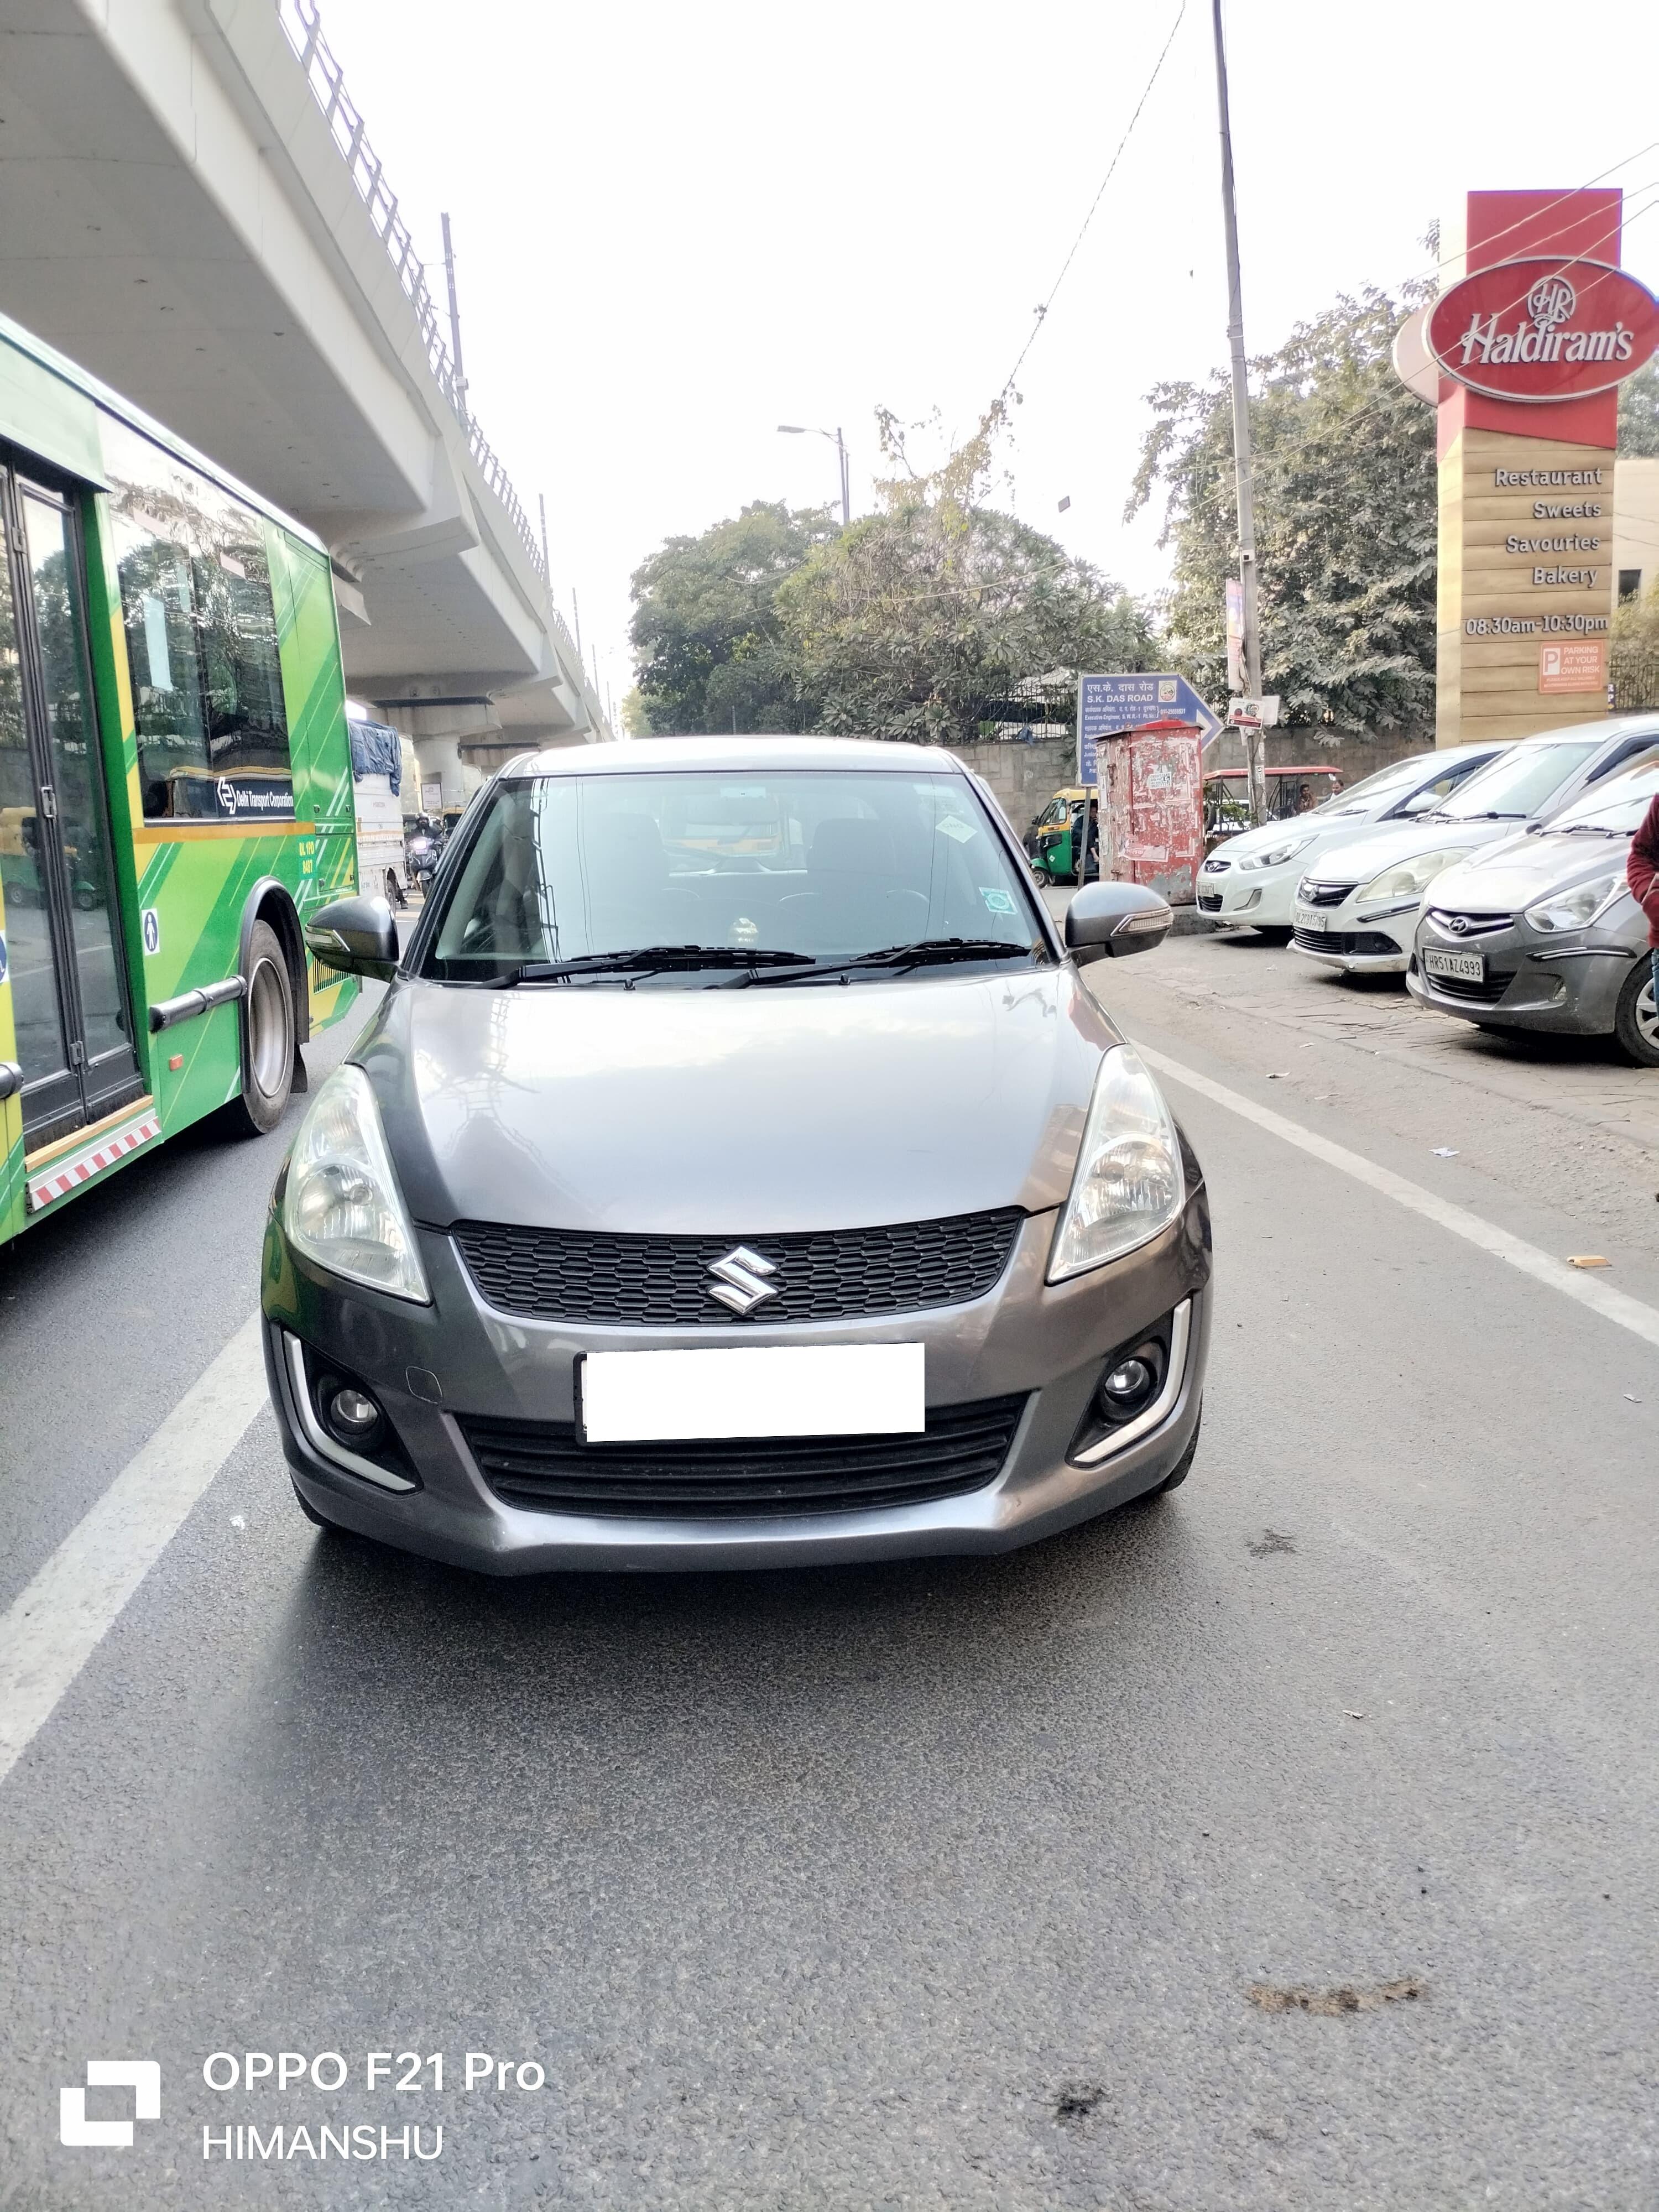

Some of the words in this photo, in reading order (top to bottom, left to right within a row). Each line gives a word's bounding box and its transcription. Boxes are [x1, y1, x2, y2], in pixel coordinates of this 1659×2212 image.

[1460, 314, 1634, 364] Haldiram's
[1495, 468, 1602, 487] Restaurant
[1533, 501, 1601, 519] Sweets
[1506, 534, 1600, 552] Savouries
[1533, 566, 1598, 588] Bakery
[1466, 614, 1608, 635] 08:30am-10:30pm
[1564, 646, 1598, 655] PARKING
[1561, 666, 1581, 675] OWN
[1118, 684, 1135, 692] दास
[1139, 681, 1154, 691] रोड
[236, 790, 249, 807] Delhi
[248, 791, 270, 811] Transport
[269, 791, 294, 807] Corporation
[1429, 954, 1480, 975] HR51AZ4993
